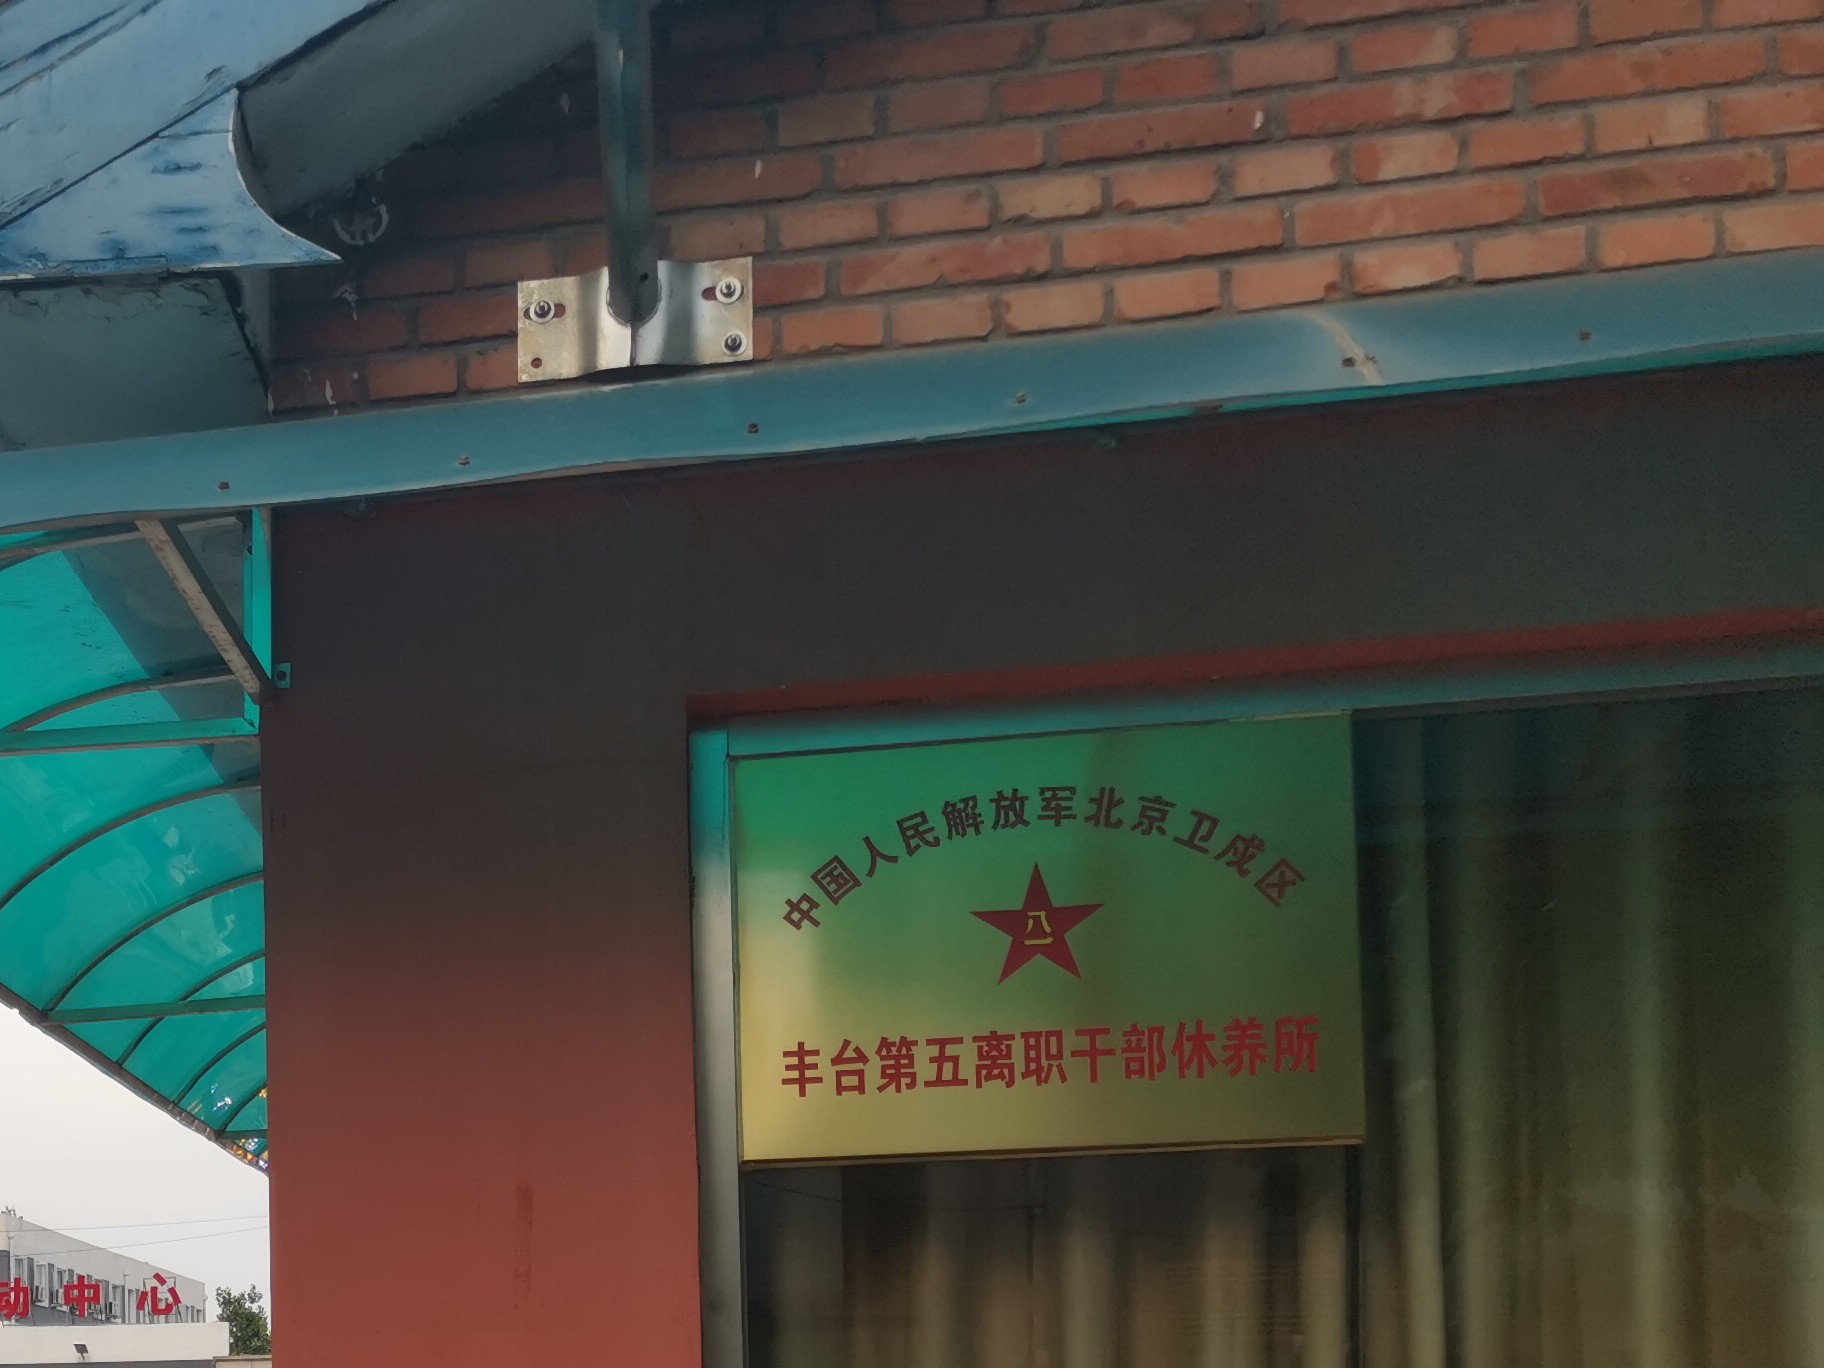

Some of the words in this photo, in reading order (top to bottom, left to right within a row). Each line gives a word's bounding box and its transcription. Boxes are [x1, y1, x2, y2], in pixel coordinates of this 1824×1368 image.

[782, 785, 1306, 932] 中国人民解放军北京卫戍区
[1022, 909, 1055, 946] 八一
[781, 1013, 1321, 1098] 丰台第五离职干部休养所
